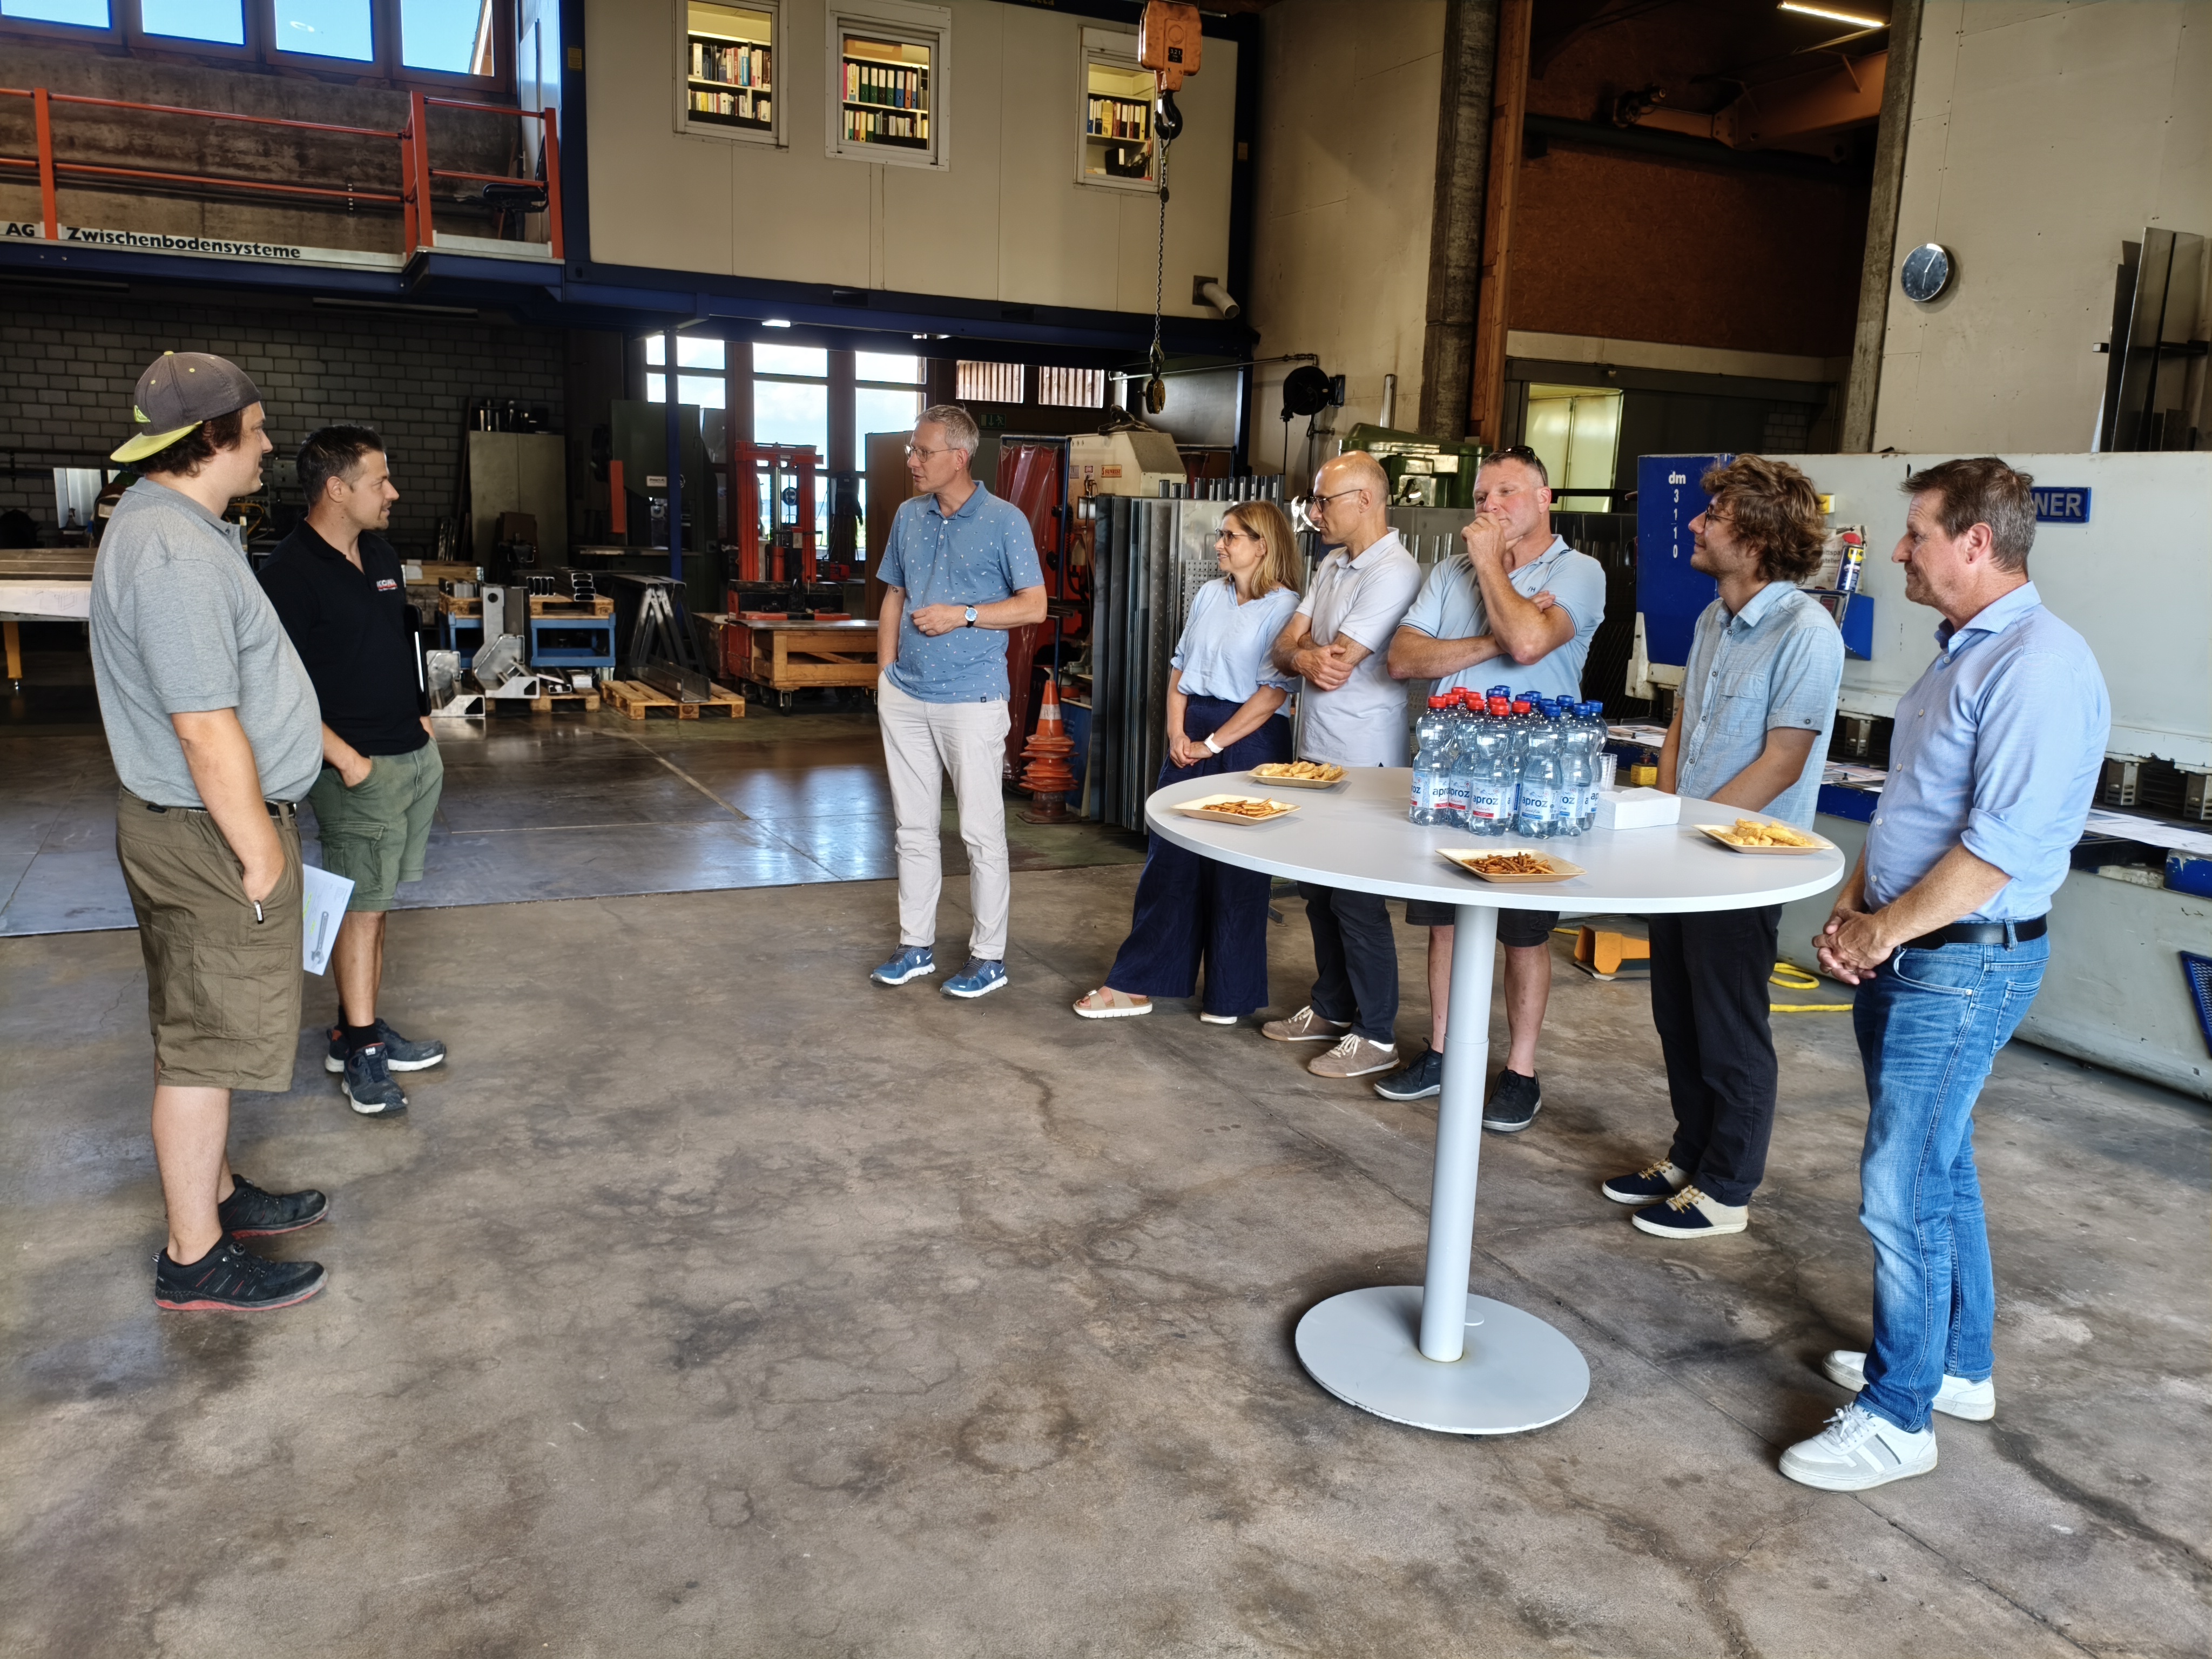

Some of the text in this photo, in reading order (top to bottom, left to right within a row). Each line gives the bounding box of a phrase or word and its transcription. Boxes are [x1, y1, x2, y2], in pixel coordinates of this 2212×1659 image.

[5, 222, 301, 258] AG Zwischenbodensysteme
[1668, 470, 1687, 484] dm
[2031, 492, 2082, 517] NER
[1473, 795, 1499, 805] aproz
[1522, 796, 1548, 808] aproz
